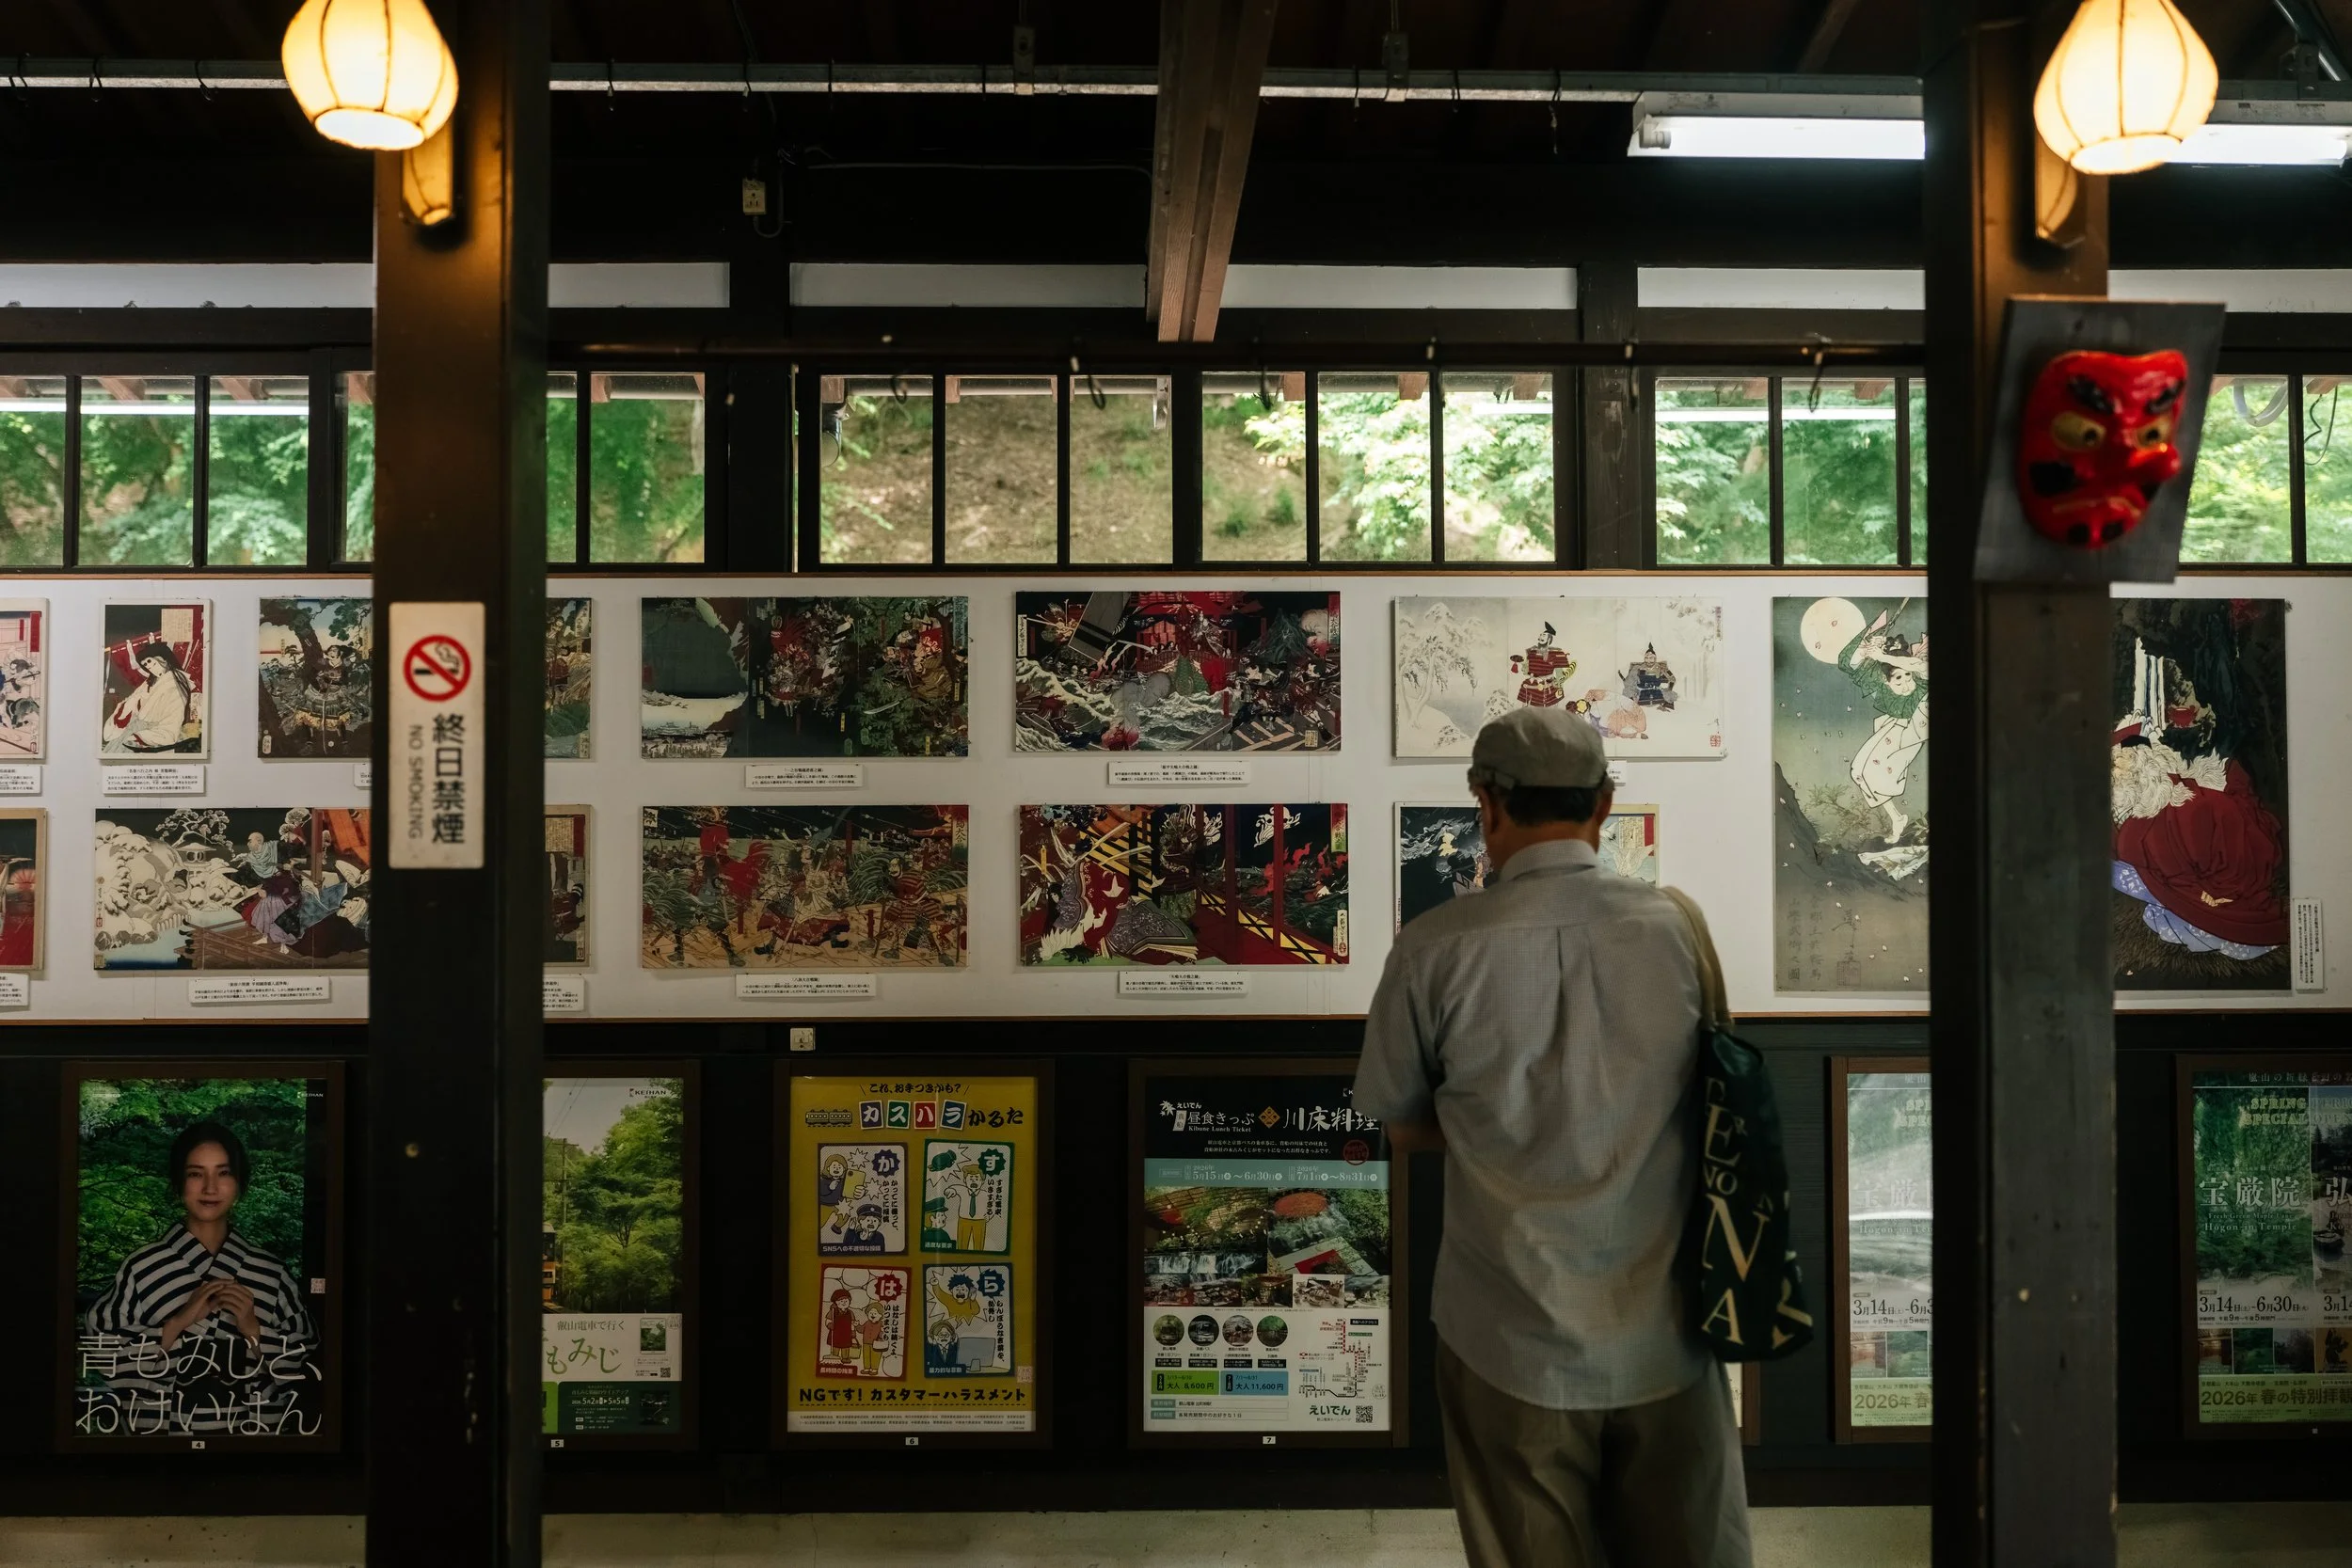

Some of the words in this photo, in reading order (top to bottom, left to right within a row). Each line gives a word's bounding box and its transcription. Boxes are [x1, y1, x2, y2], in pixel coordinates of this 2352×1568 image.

[408, 724, 423, 751] NO
[432, 713, 467, 845] 終日禁煙
[408, 756, 423, 840] SMOKING
[869, 1083, 961, 1094] これ、お手つきかも?
[2250, 1097, 2308, 1110] SPRING
[862, 1105, 1024, 1129] カスハラかるた
[1187, 1111, 1255, 1126] 昼食きっぷ
[1283, 1105, 1380, 1132] 川床料理
[2245, 1113, 2310, 1125] SPECIAL
[877, 1156, 895, 1172] か
[983, 1155, 999, 1172] す
[1852, 1178, 1932, 1210] 宝厳
[2199, 1176, 2302, 1207] 宝厳院
[2259, 1222, 2297, 1232] Temple
[880, 1279, 897, 1295] は
[984, 1276, 999, 1293] ら
[557, 1320, 625, 1331] 叡山電車で行く
[77, 1332, 324, 1382] 青もみじと、
[543, 1328, 622, 1375] もみじ
[799, 1387, 863, 1402] NGです!
[870, 1387, 1026, 1402] カスタマーハラスメント
[1854, 1393, 1912, 1409] 2026年
[2201, 1390, 2258, 1406] 2026年
[2261, 1388, 2352, 1405] 春の特別拝観
[75, 1387, 323, 1436] おけいはん
[1309, 1404, 1351, 1416] えいでん
